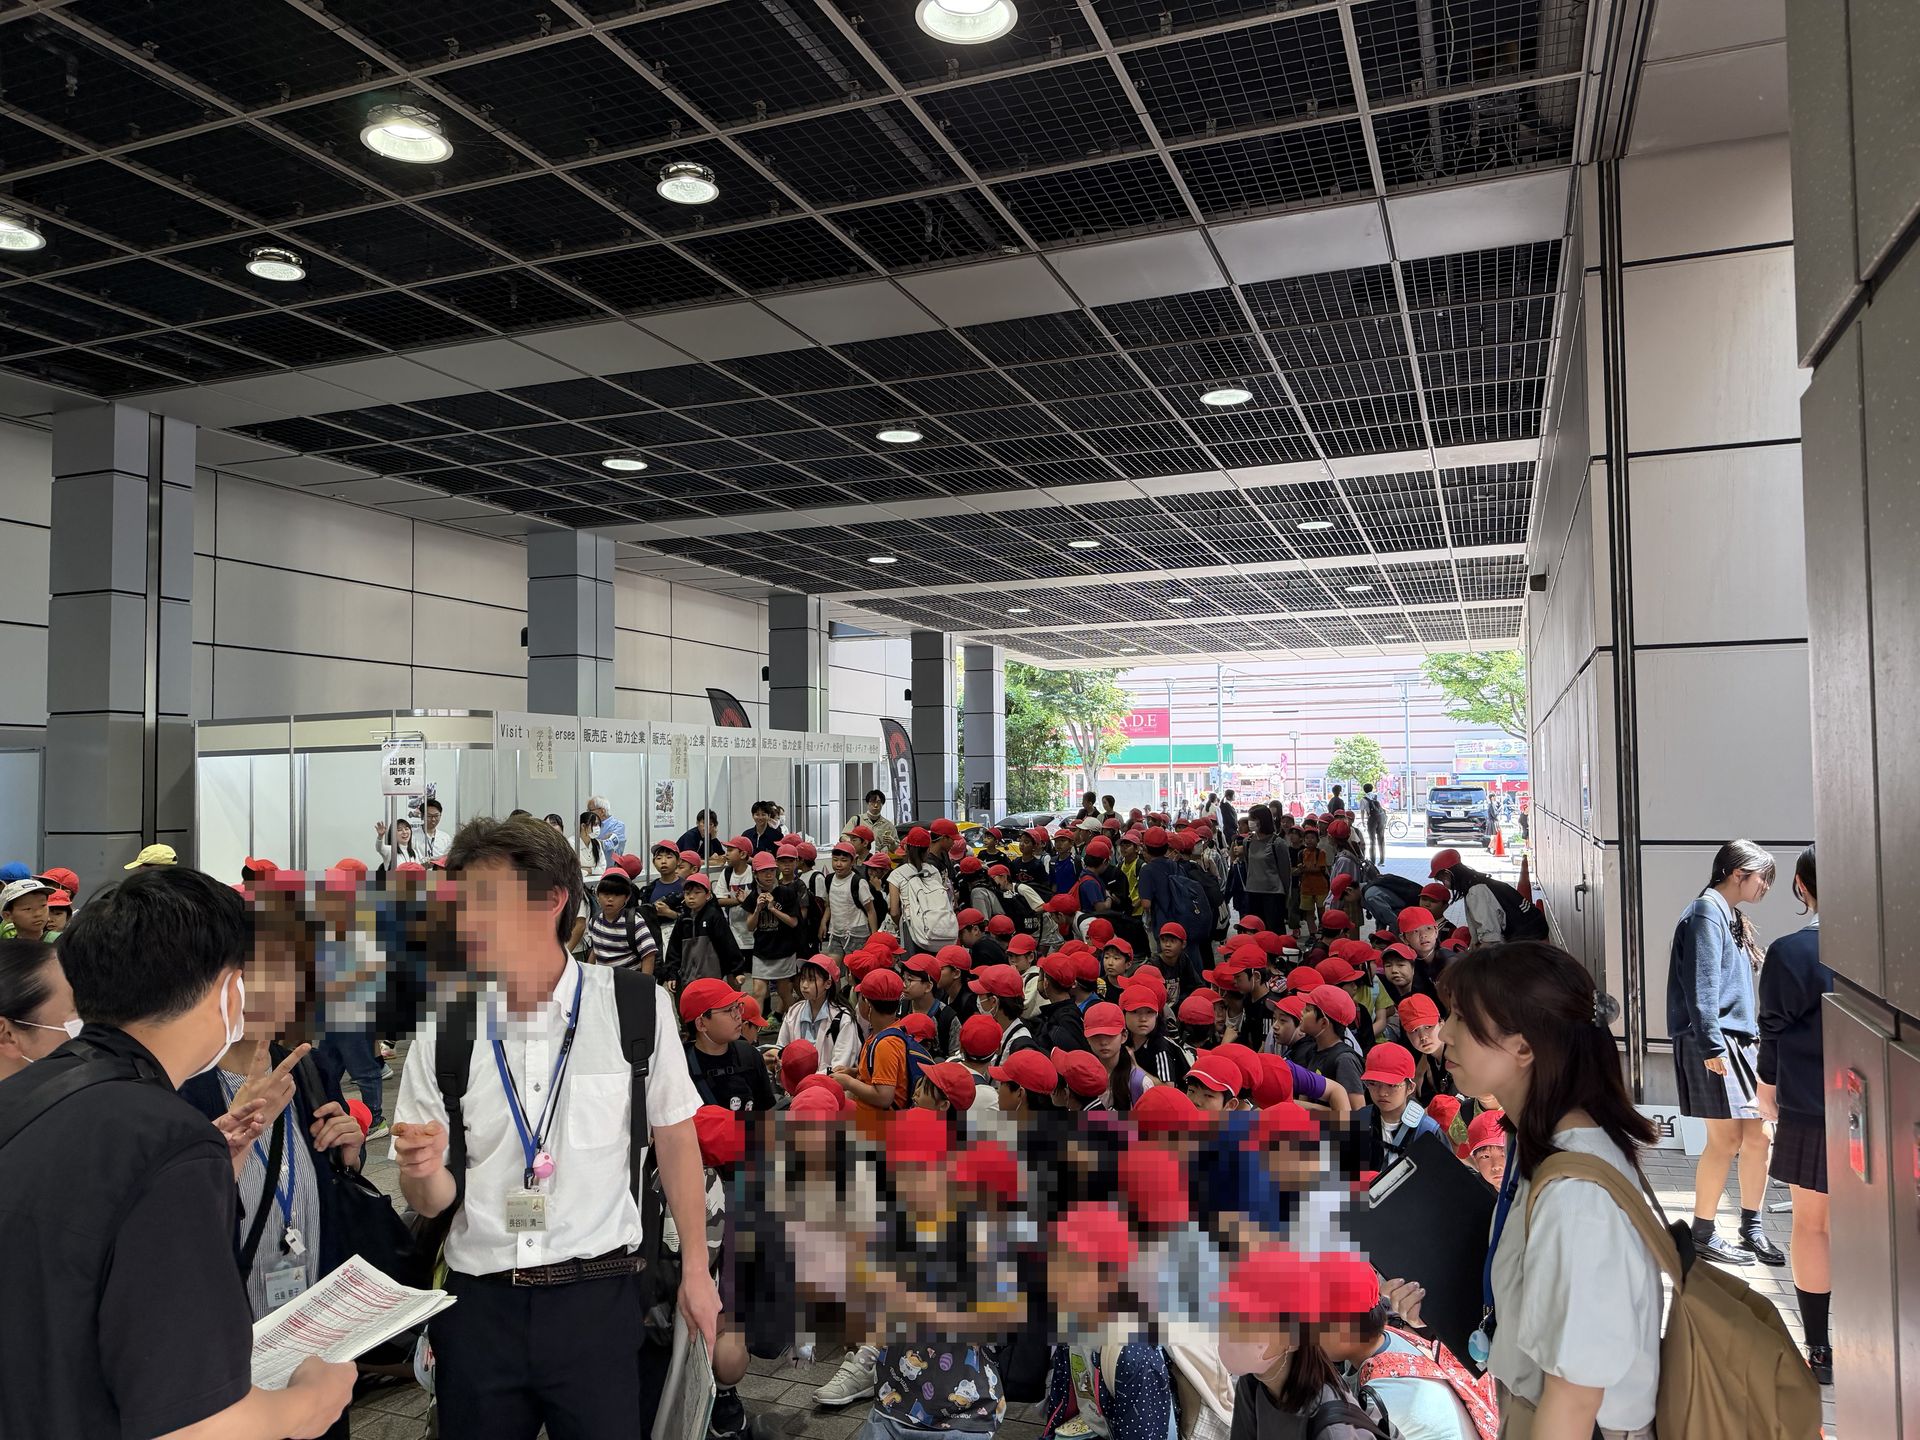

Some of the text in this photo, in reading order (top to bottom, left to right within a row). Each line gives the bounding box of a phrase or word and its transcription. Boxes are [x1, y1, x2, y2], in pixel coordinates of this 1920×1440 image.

[500, 724, 523, 738] Visit
[583, 728, 646, 744] 販売店・協力企業
[710, 736, 757, 749] 販売店・協力企業
[761, 738, 803, 751] 販売店・協力企業
[536, 730, 544, 773] 学校受付
[389, 757, 415, 766] 出展者
[389, 767, 415, 776] 関係者
[394, 777, 412, 786] 受付
